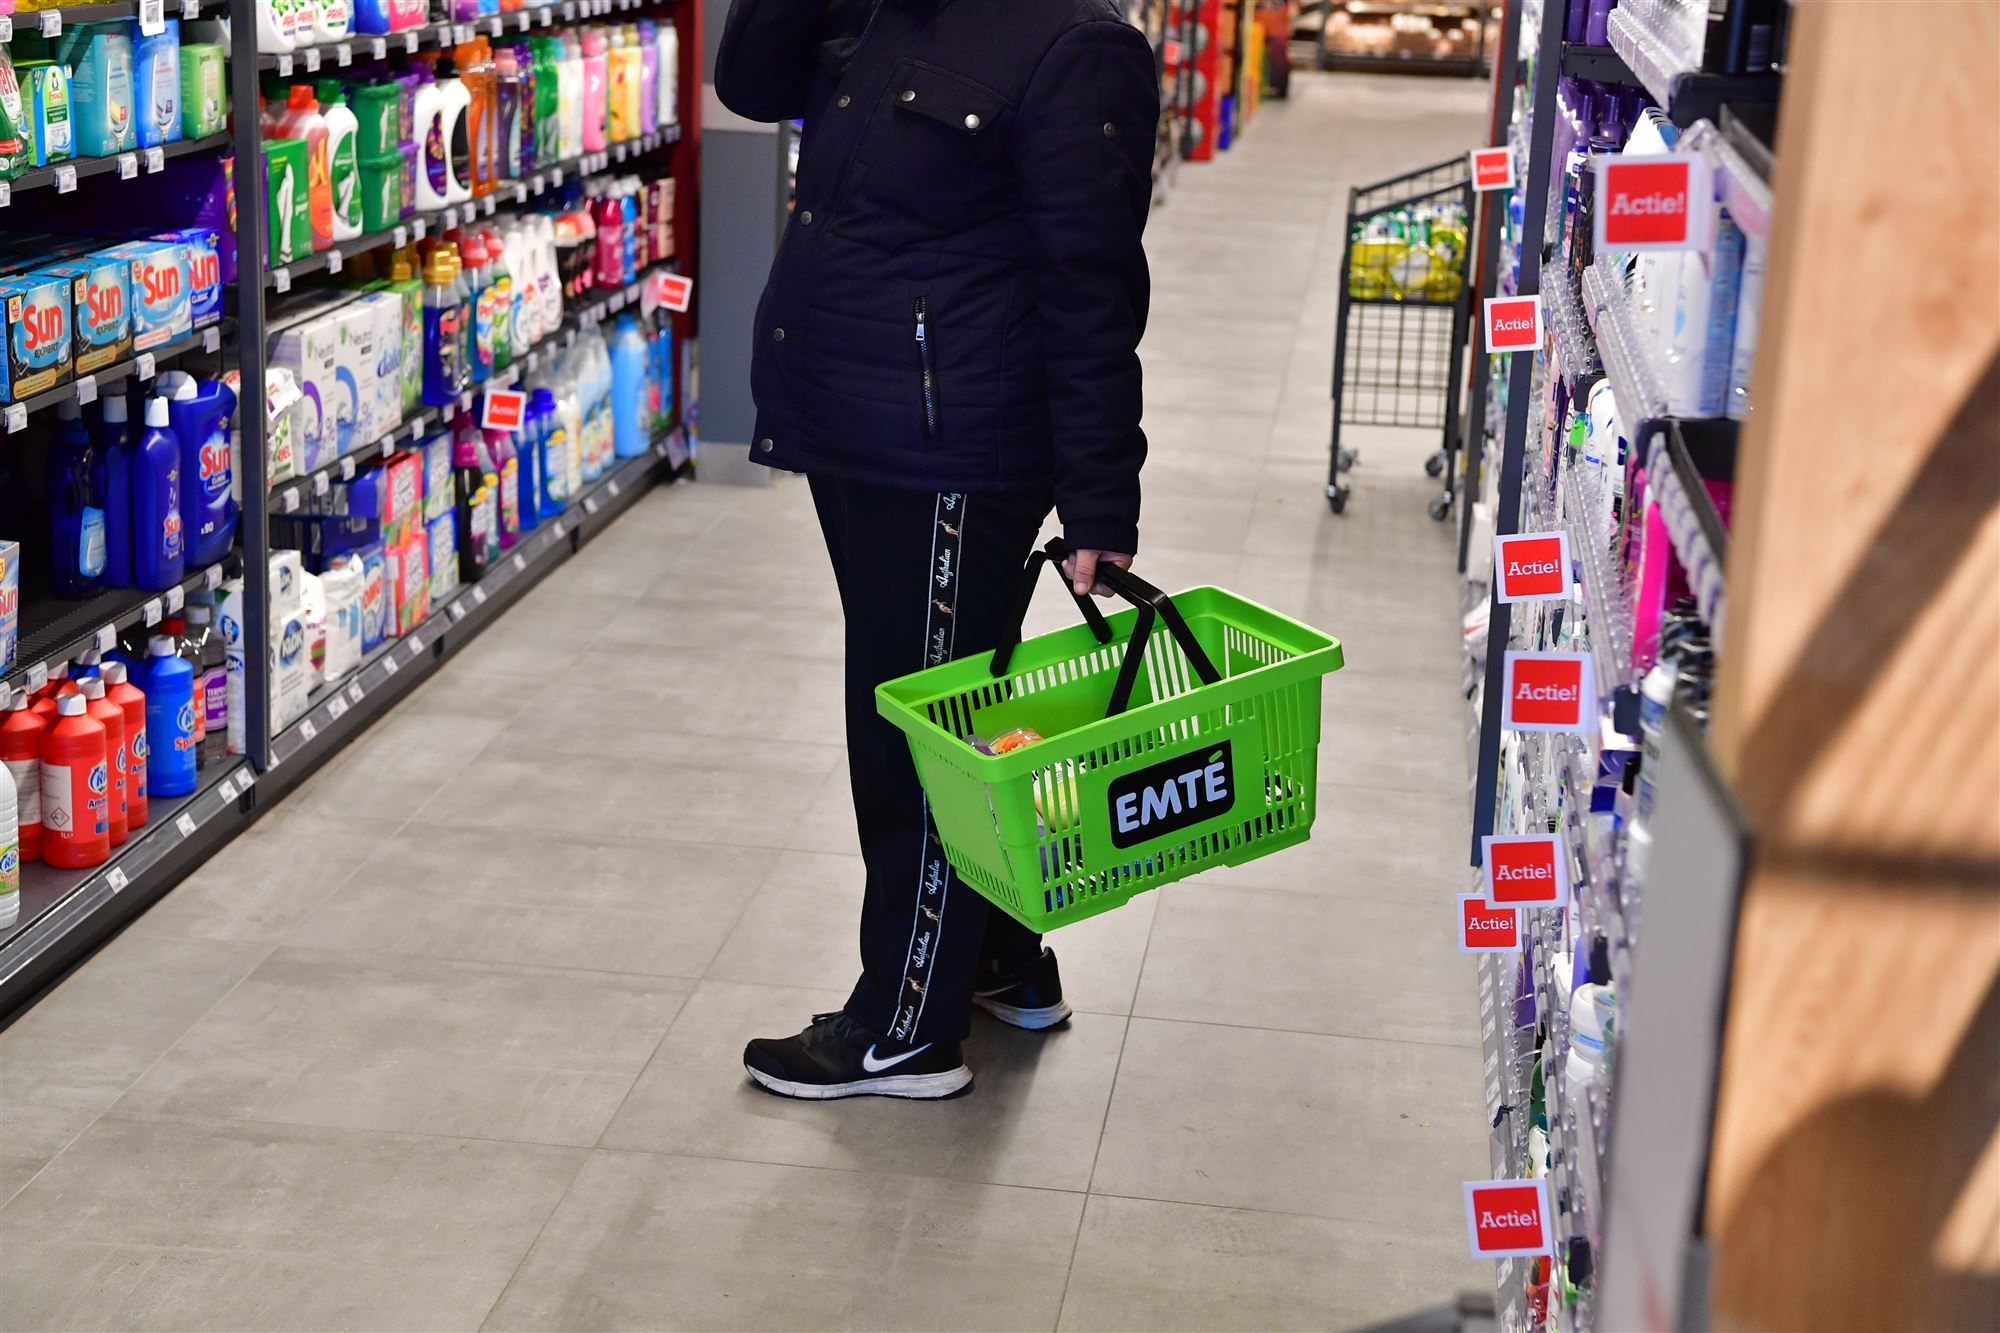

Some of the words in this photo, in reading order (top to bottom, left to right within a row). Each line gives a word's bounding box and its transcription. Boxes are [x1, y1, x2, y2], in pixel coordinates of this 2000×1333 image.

[1610, 191, 1686, 216] Actie!
[143, 266, 179, 305] Sun
[87, 284, 122, 328] Sun
[23, 304, 63, 350] Sun
[1493, 316, 1534, 331] Actie!
[201, 446, 231, 478] Sun
[1507, 559, 1559, 577] Actie!
[1515, 683, 1577, 702] Actie!
[1116, 750, 1228, 834] EMTÉ
[1495, 863, 1552, 881] Actie!
[1467, 916, 1514, 930] Actie!
[1479, 1209, 1538, 1229] Actie!
